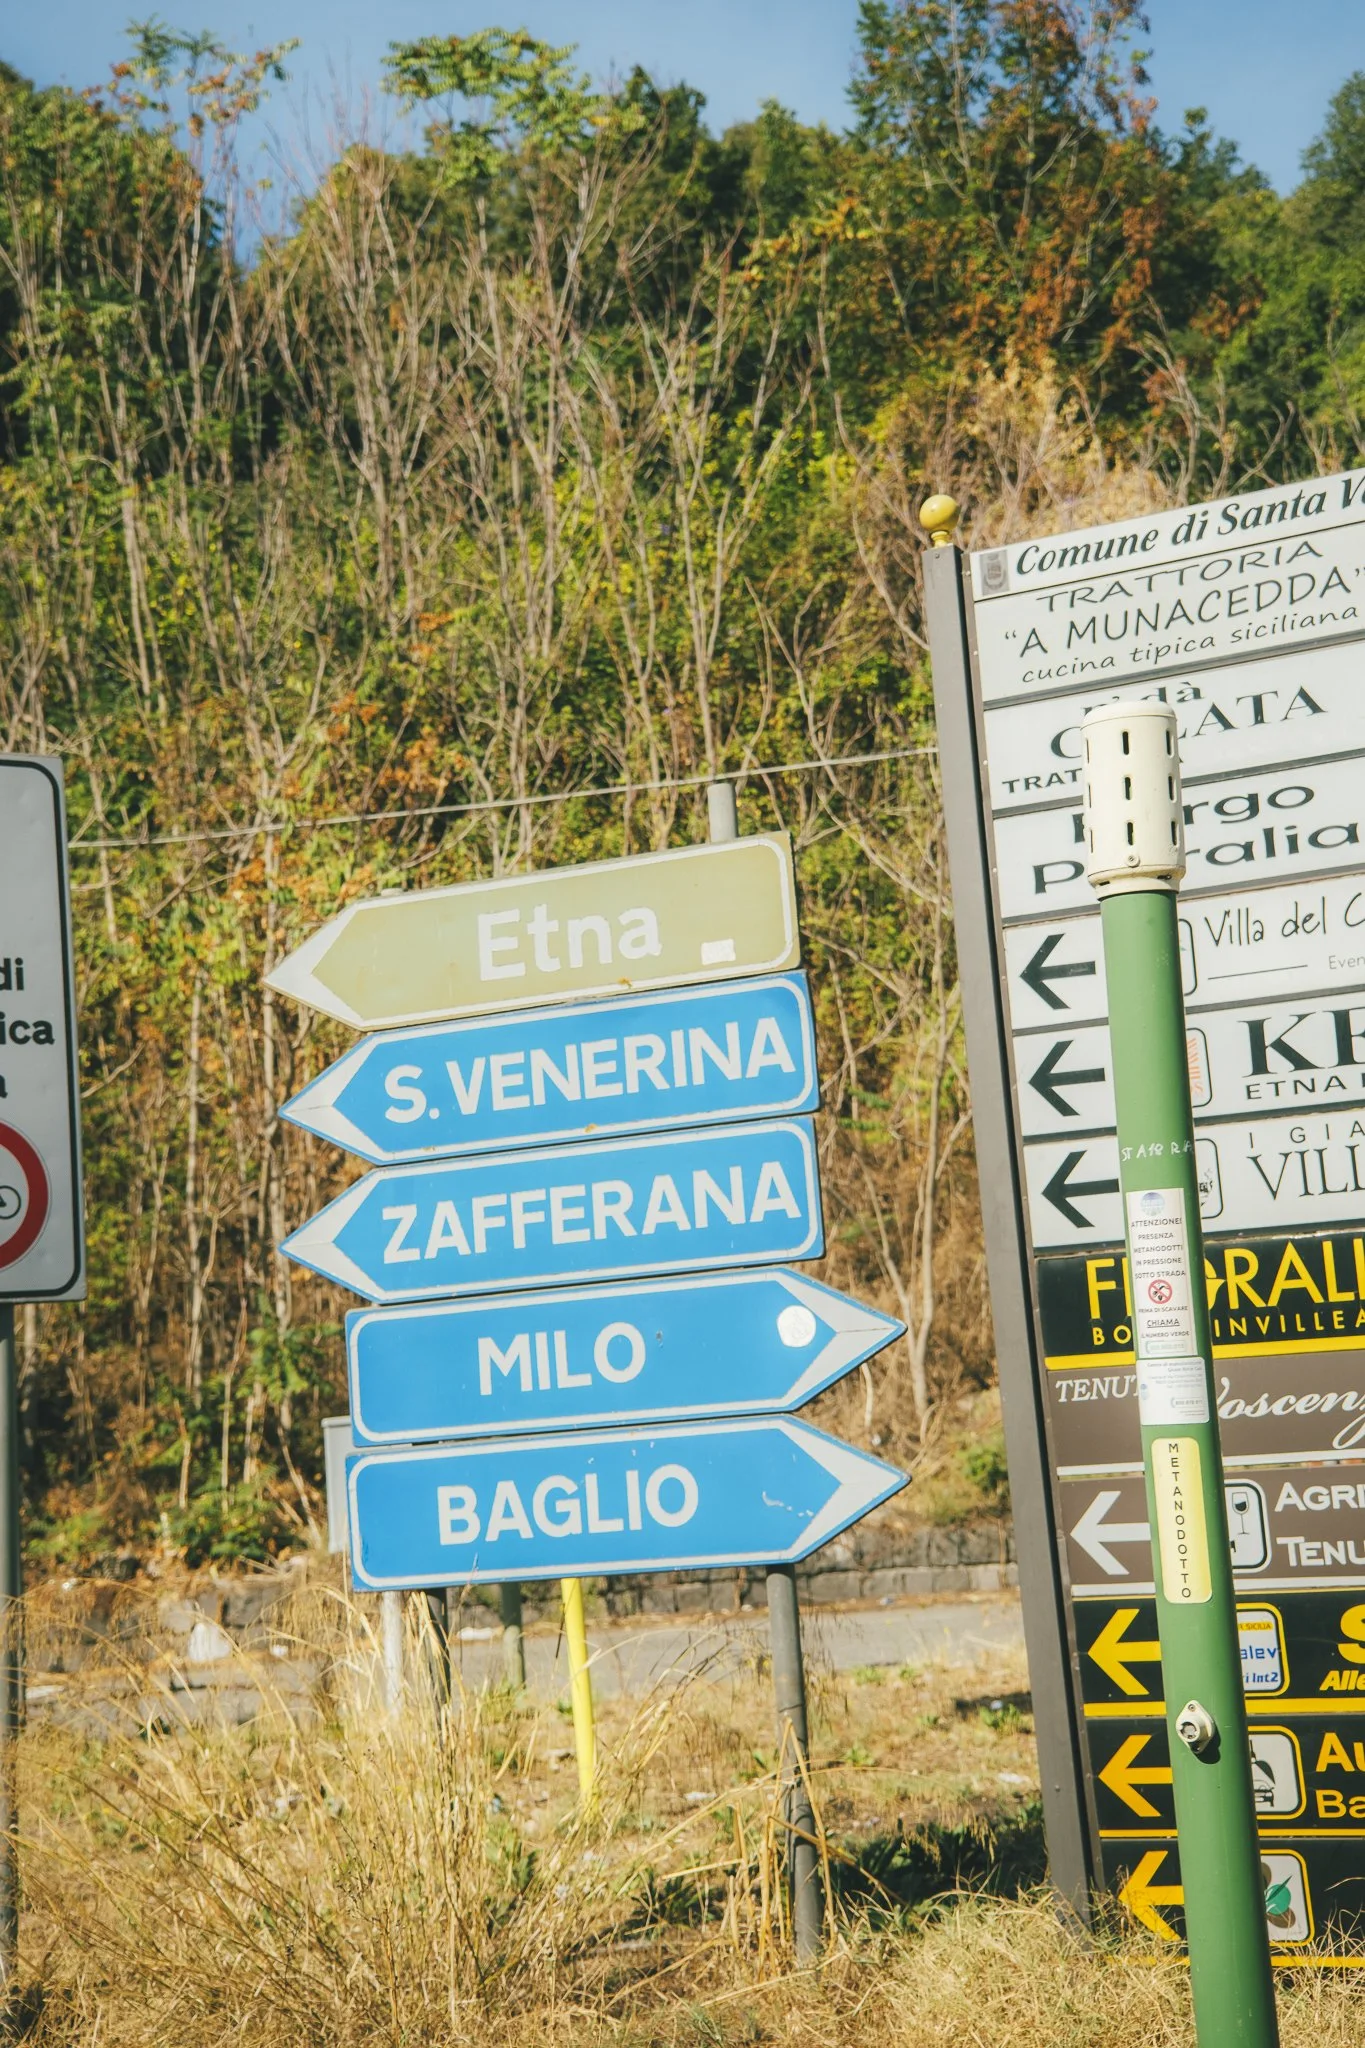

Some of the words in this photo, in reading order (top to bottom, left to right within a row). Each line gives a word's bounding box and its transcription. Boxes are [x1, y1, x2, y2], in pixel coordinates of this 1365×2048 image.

[1017, 529, 1159, 575] Comune
[1172, 510, 1209, 545] di
[1217, 490, 1327, 536] Santa
[1341, 475, 1365, 509] V
[1036, 541, 1323, 612] TRATTORIA
[1022, 655, 1114, 684] cucina
[1131, 633, 1216, 665] tipica
[1231, 605, 1358, 644] siciliana
[477, 905, 661, 982] Etna
[1204, 906, 1264, 947] Villa
[1282, 895, 1326, 937] del
[1246, 1075, 1347, 1100] ETNA
[381, 1161, 802, 1264] ZAFFERANA
[1138, 1232, 1174, 1240] PRESENZA
[1134, 1271, 1156, 1280] SOTTO
[1157, 1270, 1186, 1278] STRADA
[1143, 1257, 1182, 1266] PRESSIONE
[477, 1321, 646, 1396] MILO
[1147, 1318, 1180, 1328] CHIAMA
[437, 1463, 699, 1546] BAGLIO
[1168, 1442, 1191, 1599] METANODOTTO
